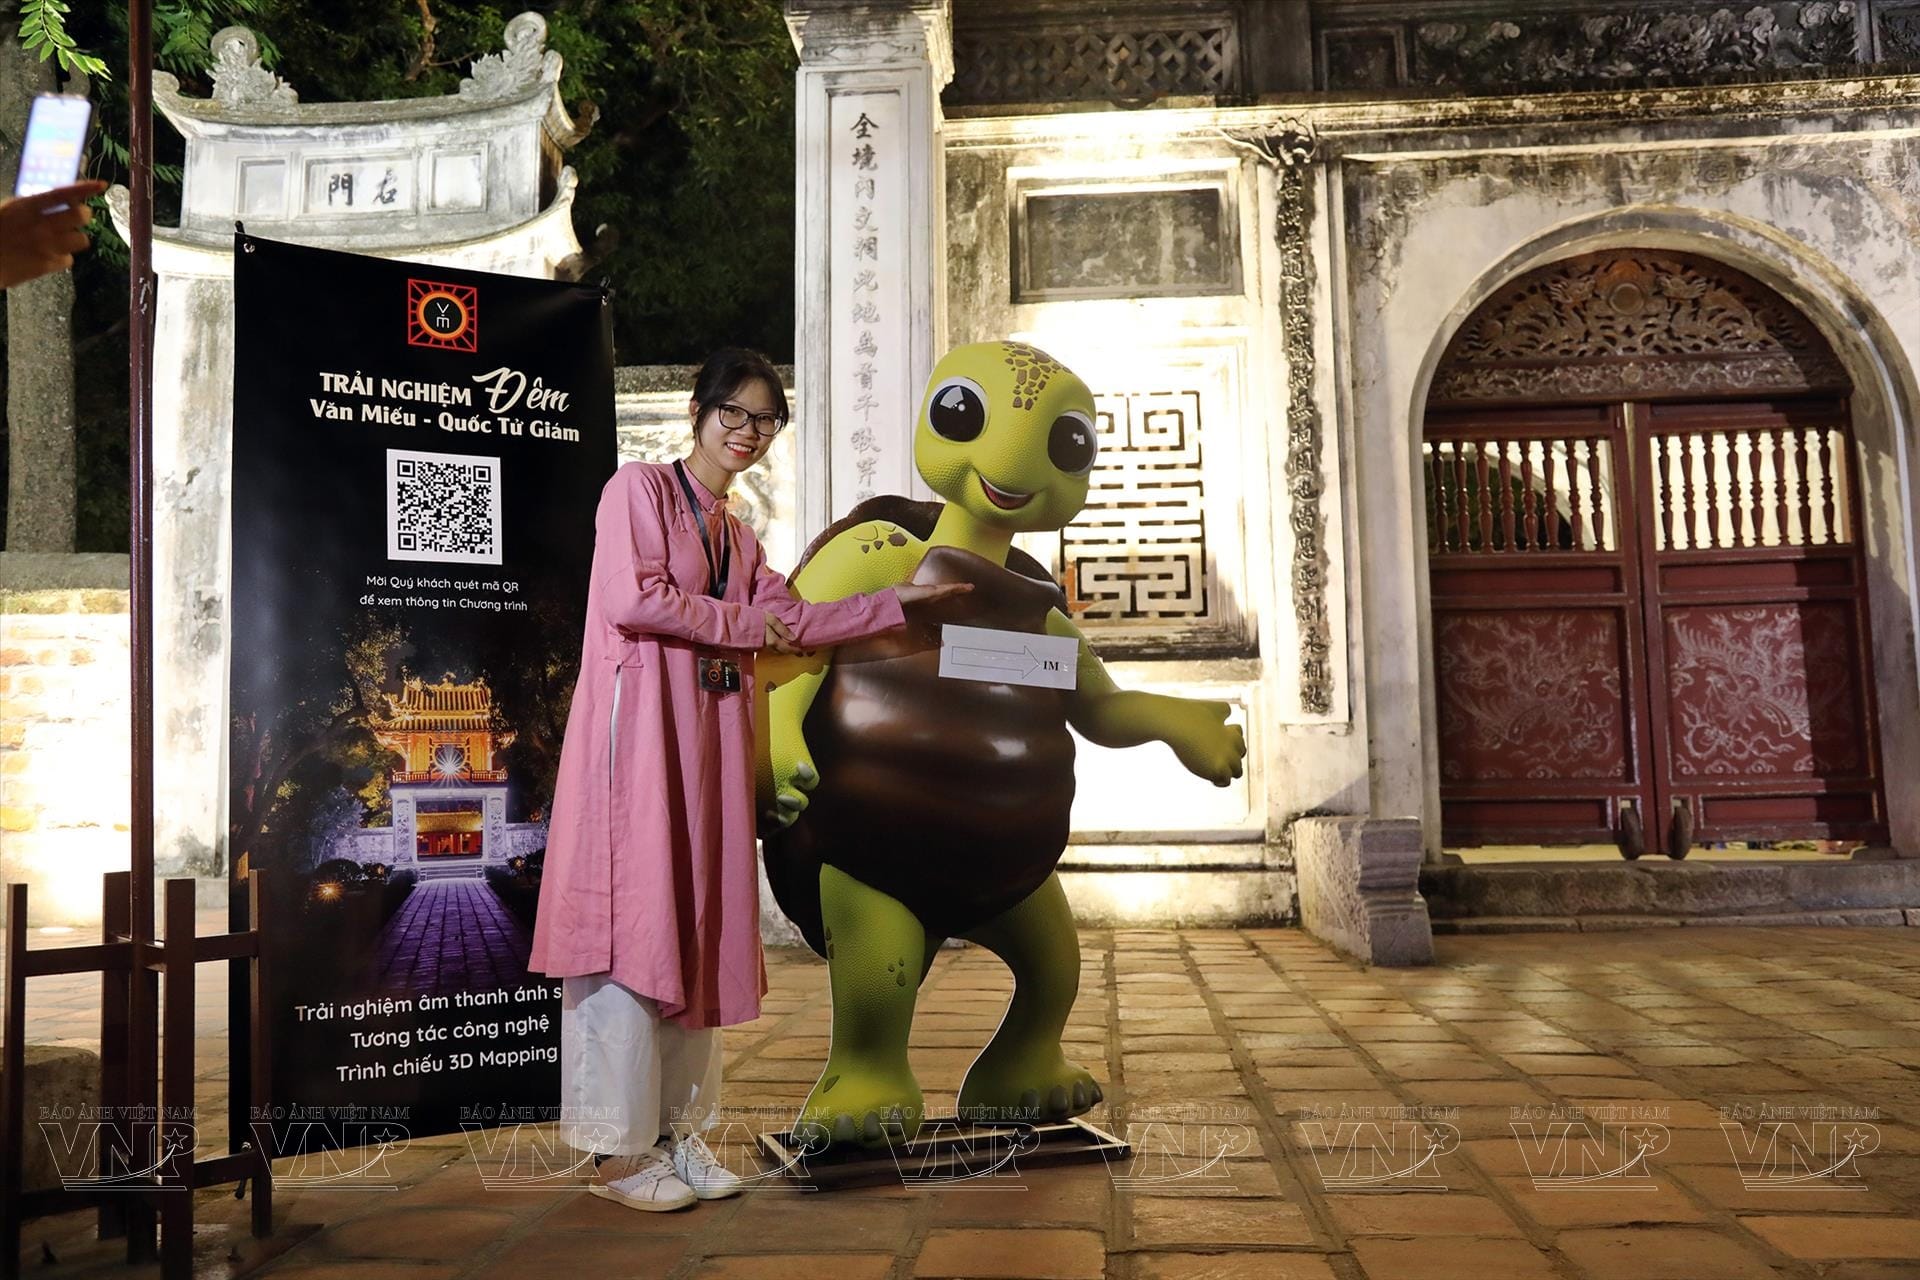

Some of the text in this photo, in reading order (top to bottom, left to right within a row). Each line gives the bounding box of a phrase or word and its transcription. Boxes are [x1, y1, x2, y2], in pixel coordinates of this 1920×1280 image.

[319, 366, 570, 414] TRẢI NGHIỆM Đêm
[310, 398, 353, 421] Văn
[361, 404, 416, 427] Miếu
[438, 411, 492, 433] Quốc
[497, 416, 525, 436] Tử
[529, 420, 580, 442] Giám
[366, 575, 519, 594] Mời Quý khách quét mã QR
[377, 597, 403, 607] xem
[405, 596, 439, 610] thông
[442, 598, 457, 608] tin
[459, 598, 501, 612] Chương
[503, 600, 528, 612] trình
[294, 1003, 334, 1022] Trải
[340, 997, 413, 1021] nghiệm
[418, 994, 449, 1011] âm
[454, 988, 509, 1008] thanh
[514, 985, 548, 1003] ánh
[350, 1014, 550, 1049] Tương tác công nghệ
[336, 1045, 558, 1082] Trình chiếu 3D Mapping
